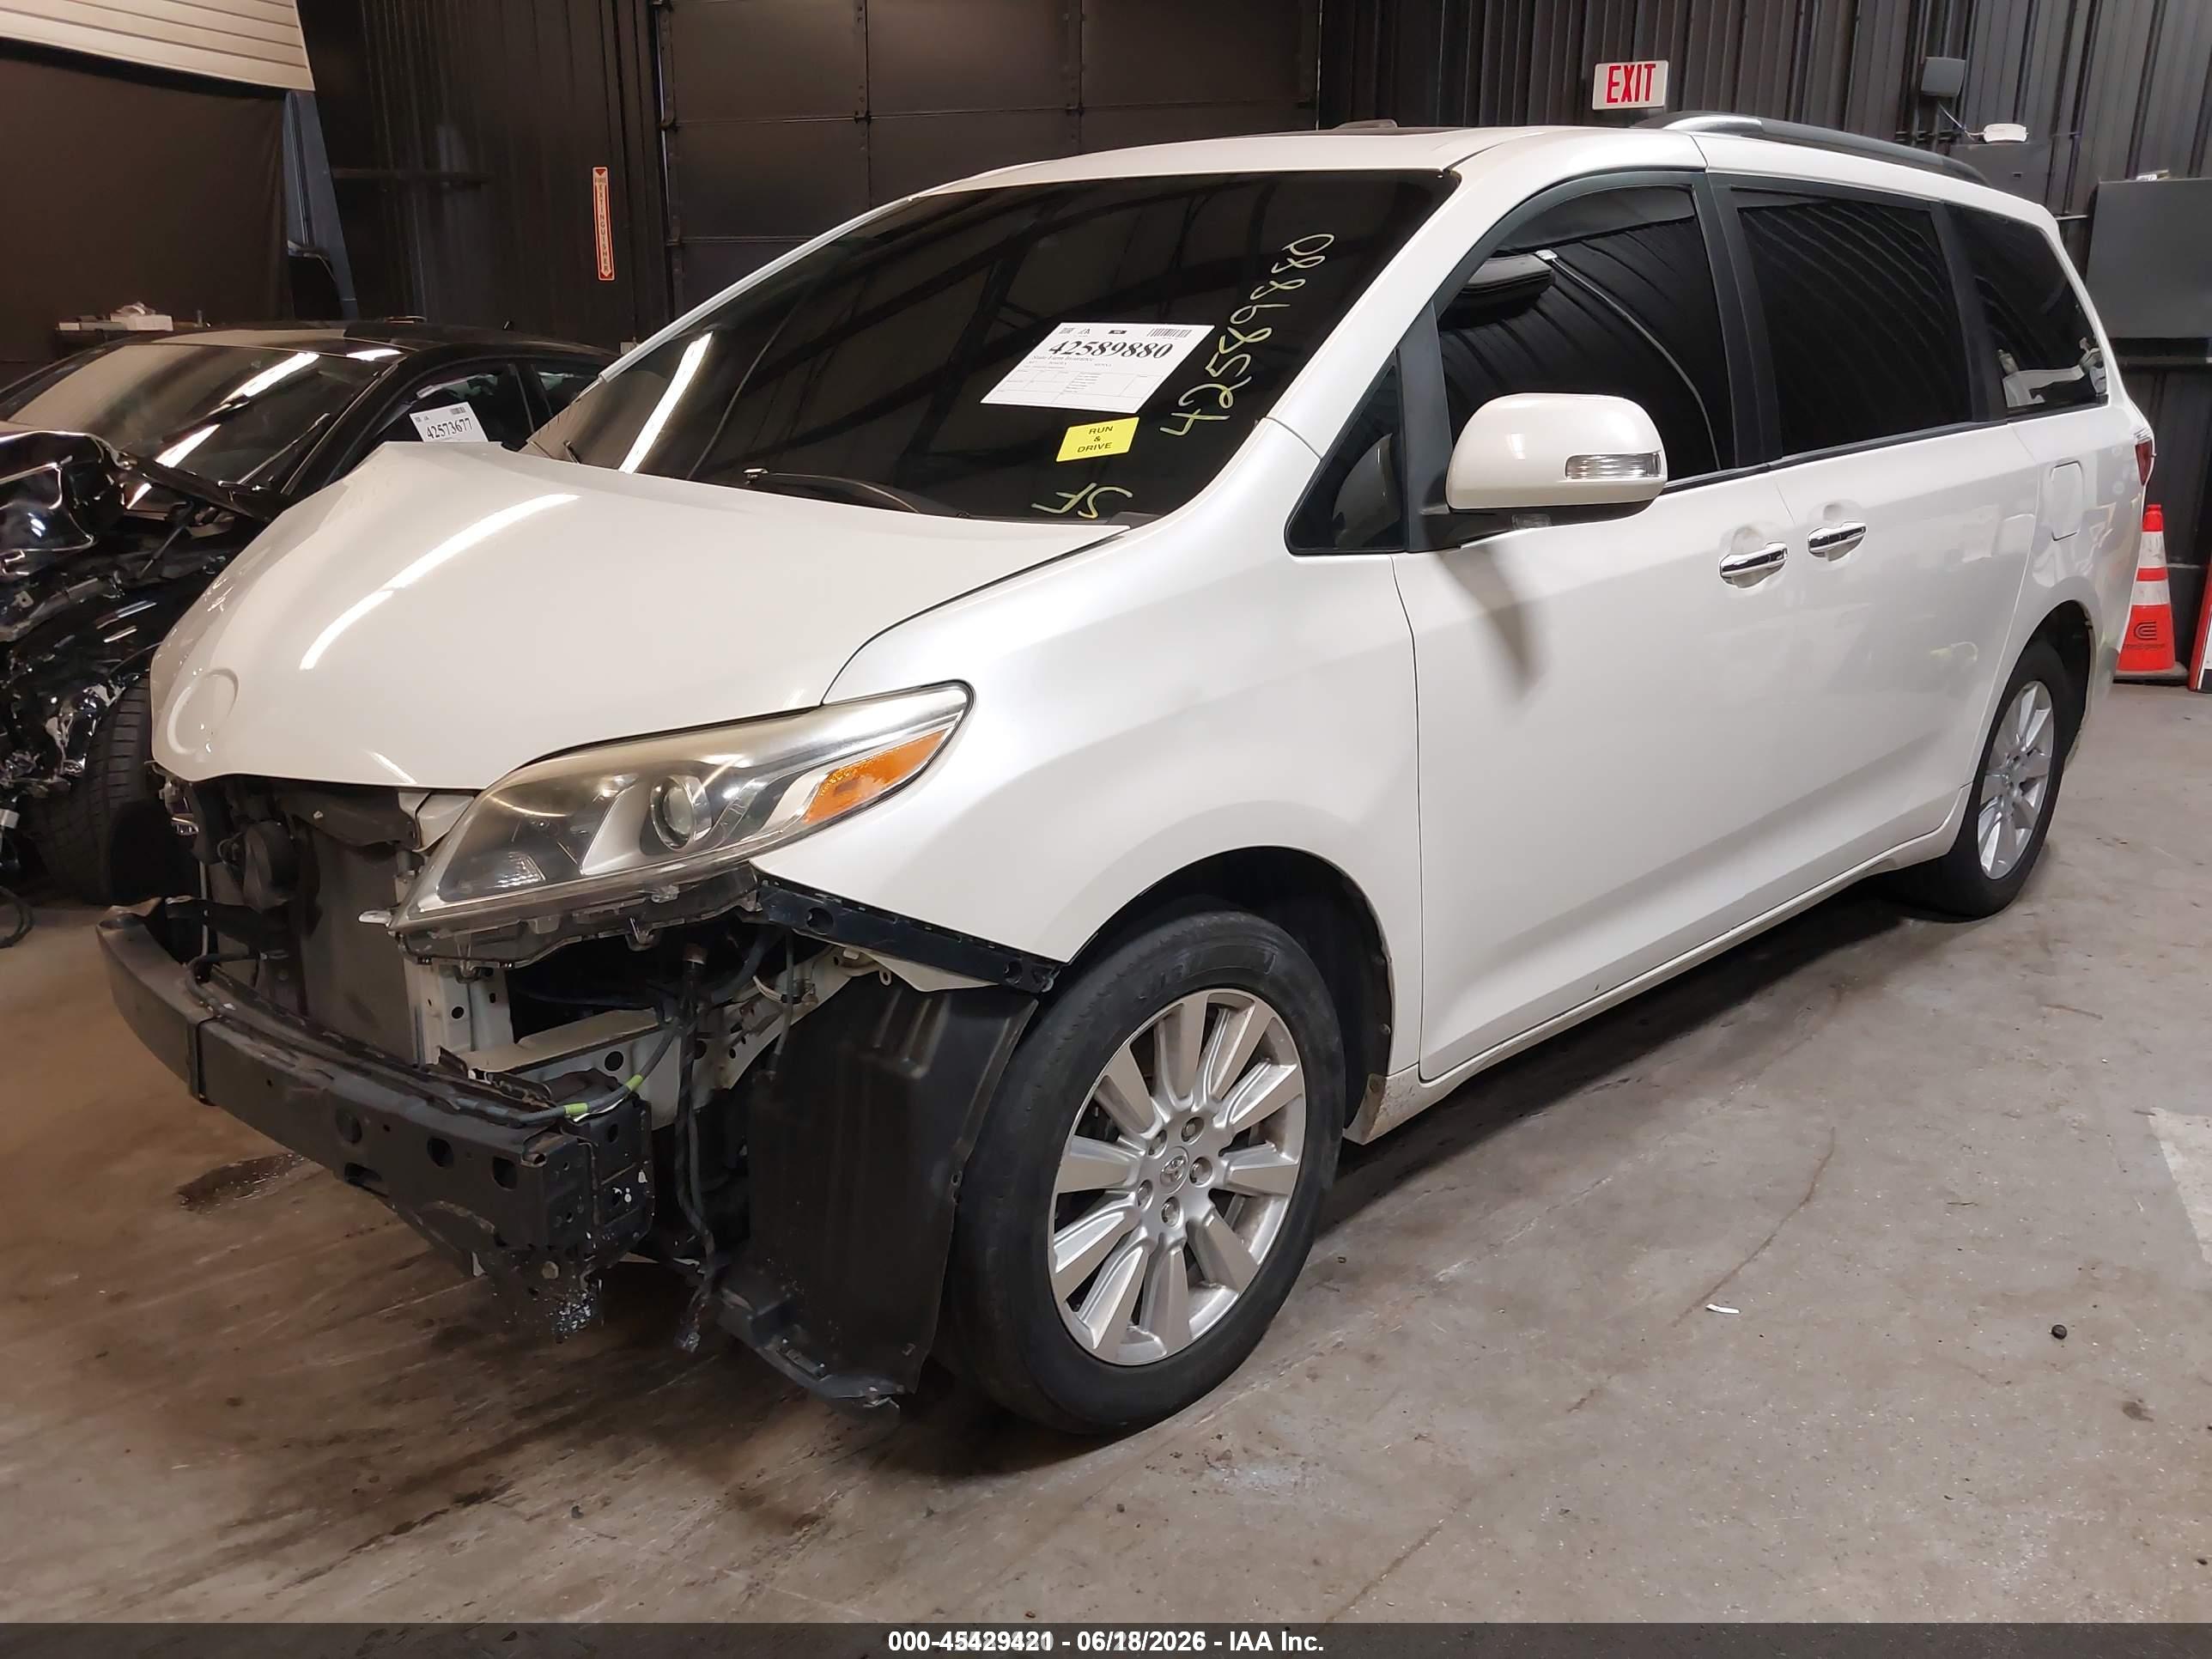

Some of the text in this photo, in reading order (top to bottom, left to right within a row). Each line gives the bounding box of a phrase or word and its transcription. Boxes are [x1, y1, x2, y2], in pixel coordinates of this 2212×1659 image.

[1607, 64, 1656, 103] EXIT
[1160, 234, 1334, 435] 42589880
[1048, 340, 1173, 359] 42589880
[427, 417, 473, 439] 42573677
[1089, 426, 1113, 434] RUN
[1077, 441, 1111, 453] DRIVE
